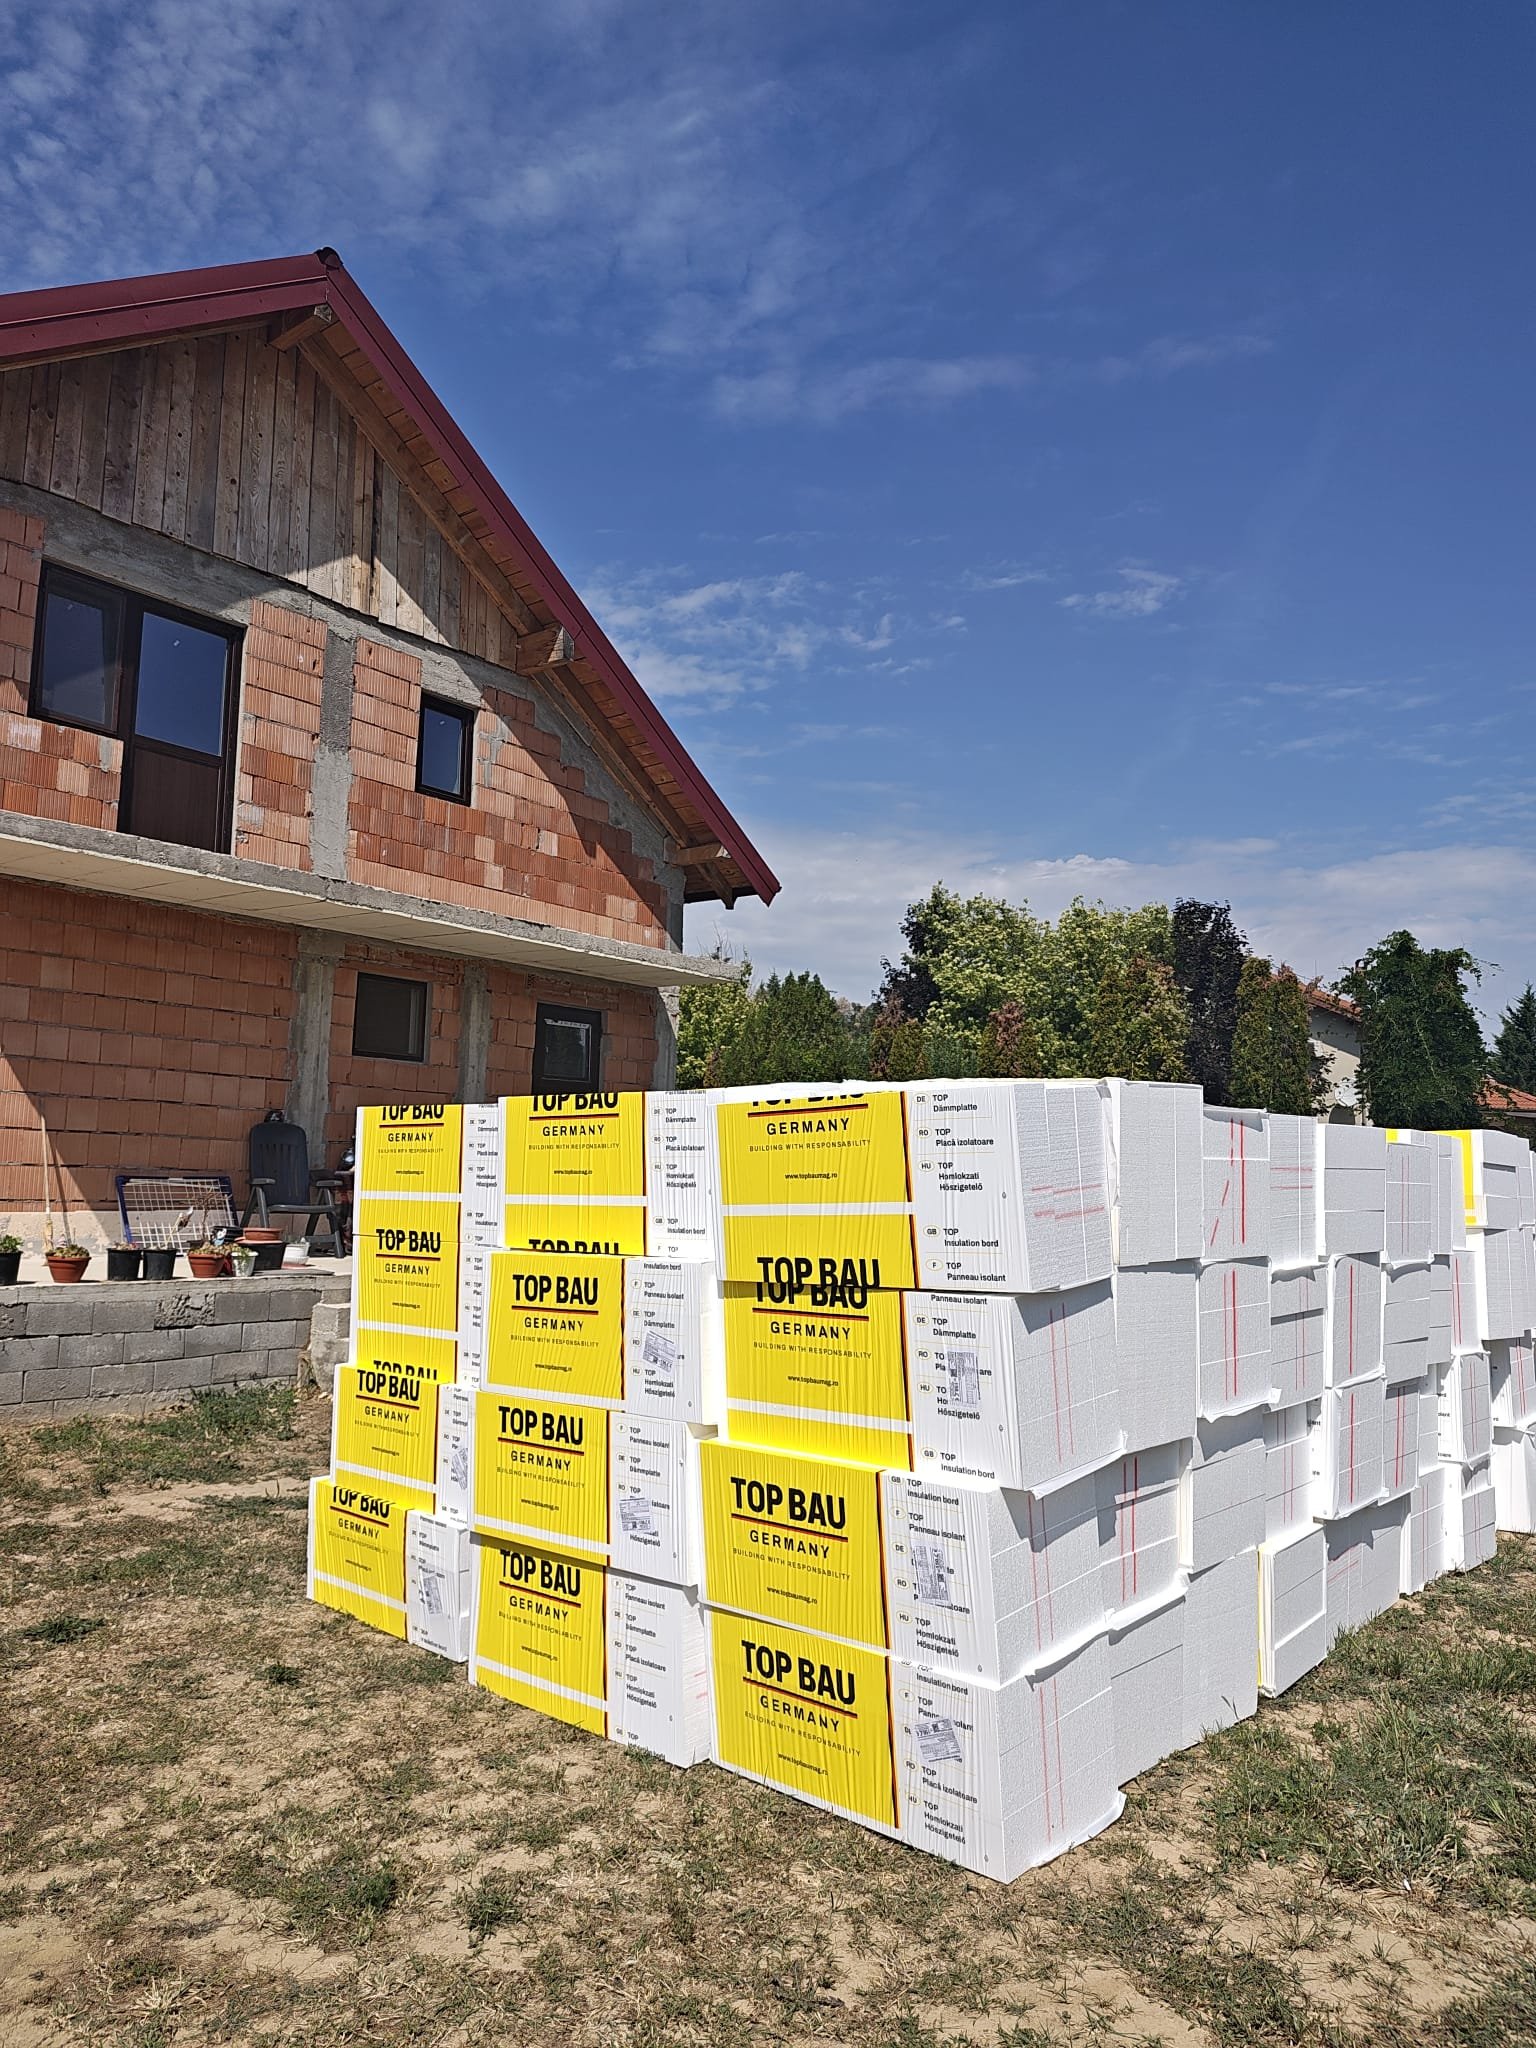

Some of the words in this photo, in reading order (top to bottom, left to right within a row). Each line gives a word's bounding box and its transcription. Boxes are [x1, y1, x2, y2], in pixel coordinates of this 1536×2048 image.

[532, 1093, 569, 1112] TOP
[575, 1092, 618, 1110] BAU
[933, 1103, 978, 1113] Dämmplatte
[382, 1105, 409, 1120] TOP
[412, 1104, 444, 1120] BAU
[543, 1124, 604, 1137] GERMANY
[767, 1117, 850, 1135] GERMANY
[935, 1128, 951, 1136] TOP
[388, 1132, 433, 1142] GERMANY
[936, 1138, 956, 1147] Placă
[957, 1138, 994, 1146] izolatoare
[750, 1143, 783, 1152] BUILDING
[785, 1142, 804, 1150] WITH
[806, 1139, 871, 1149] RESPONSABILITY
[938, 1162, 953, 1170] TOP
[939, 1172, 980, 1180] Homlokzati
[943, 1228, 959, 1236] TOP
[376, 1229, 405, 1251] TOP
[409, 1230, 440, 1253] BAU
[944, 1239, 980, 1247] Insulation
[981, 1239, 999, 1247] bord
[385, 1264, 430, 1275] GERMANY
[946, 1262, 962, 1270] TOP
[757, 1257, 813, 1284] TOP
[819, 1258, 880, 1289] BAU
[947, 1273, 979, 1281] Panneau
[980, 1273, 1006, 1282] isolant
[512, 1274, 552, 1303] TOP
[556, 1276, 598, 1305] BAU
[931, 1294, 962, 1304] Panneau
[963, 1296, 987, 1305] isolant
[525, 1317, 584, 1332] GERMANY
[932, 1317, 948, 1326] TOP
[770, 1321, 851, 1340] GERMANY
[933, 1328, 976, 1339] Dämmplatte
[753, 1341, 787, 1351] BUILDING
[789, 1345, 807, 1353] WITH
[808, 1346, 872, 1359] RESPONSABILITY
[934, 1352, 945, 1360] TO
[935, 1363, 946, 1371] Pla
[357, 1370, 386, 1394] TOP
[389, 1376, 420, 1401] BAU
[936, 1386, 947, 1394] TO
[365, 1406, 409, 1423] GERMANY
[498, 1406, 537, 1437] TOP
[542, 1412, 583, 1445] BAU
[629, 1427, 641, 1435] TOP
[511, 1451, 572, 1472] GERMANY
[630, 1456, 641, 1464] TOP
[940, 1452, 956, 1461] TOP
[941, 1464, 977, 1477] Insulation
[978, 1468, 995, 1479] bord
[907, 1479, 922, 1487] TOP
[630, 1486, 641, 1494] TOP
[730, 1477, 783, 1515] TOP
[789, 1488, 846, 1530] BAU
[907, 1490, 942, 1502] Insulation
[943, 1495, 959, 1506] bord
[909, 1513, 923, 1522] TOP
[338, 1518, 379, 1539] GERMANY
[909, 1524, 940, 1537] Panneau
[941, 1530, 966, 1541] isolant
[750, 1530, 830, 1559] GERMANY
[895, 1545, 904, 1553] DE
[733, 1548, 765, 1561] BUILDING
[767, 1555, 785, 1565] WITH
[787, 1560, 850, 1580] RESPONSABILITY
[499, 1549, 536, 1583] TOP
[540, 1560, 581, 1597] BAU
[625, 1584, 636, 1592] TOP
[897, 1579, 907, 1588] RO
[510, 1595, 568, 1623] GERMANY
[626, 1613, 637, 1622] TOP
[899, 1614, 909, 1622] HU
[915, 1617, 931, 1627] TOP
[916, 1629, 956, 1645] Homlokzati
[625, 1644, 637, 1653] TOP
[742, 1639, 791, 1683] TOP
[798, 1657, 856, 1705] BAU
[626, 1674, 637, 1683] TOP
[916, 1673, 951, 1689] Insulation
[951, 1683, 969, 1695] bord
[917, 1696, 933, 1707] TOP
[760, 1695, 840, 1733] GERMANY
[779, 1722, 796, 1735] WITH
[798, 1730, 861, 1757] RESPONSABILITY
[921, 1766, 937, 1777] TOP
[942, 1784, 978, 1803] izolatoare
[924, 1800, 938, 1811] TOP
[924, 1811, 964, 1833] Homlokzati
